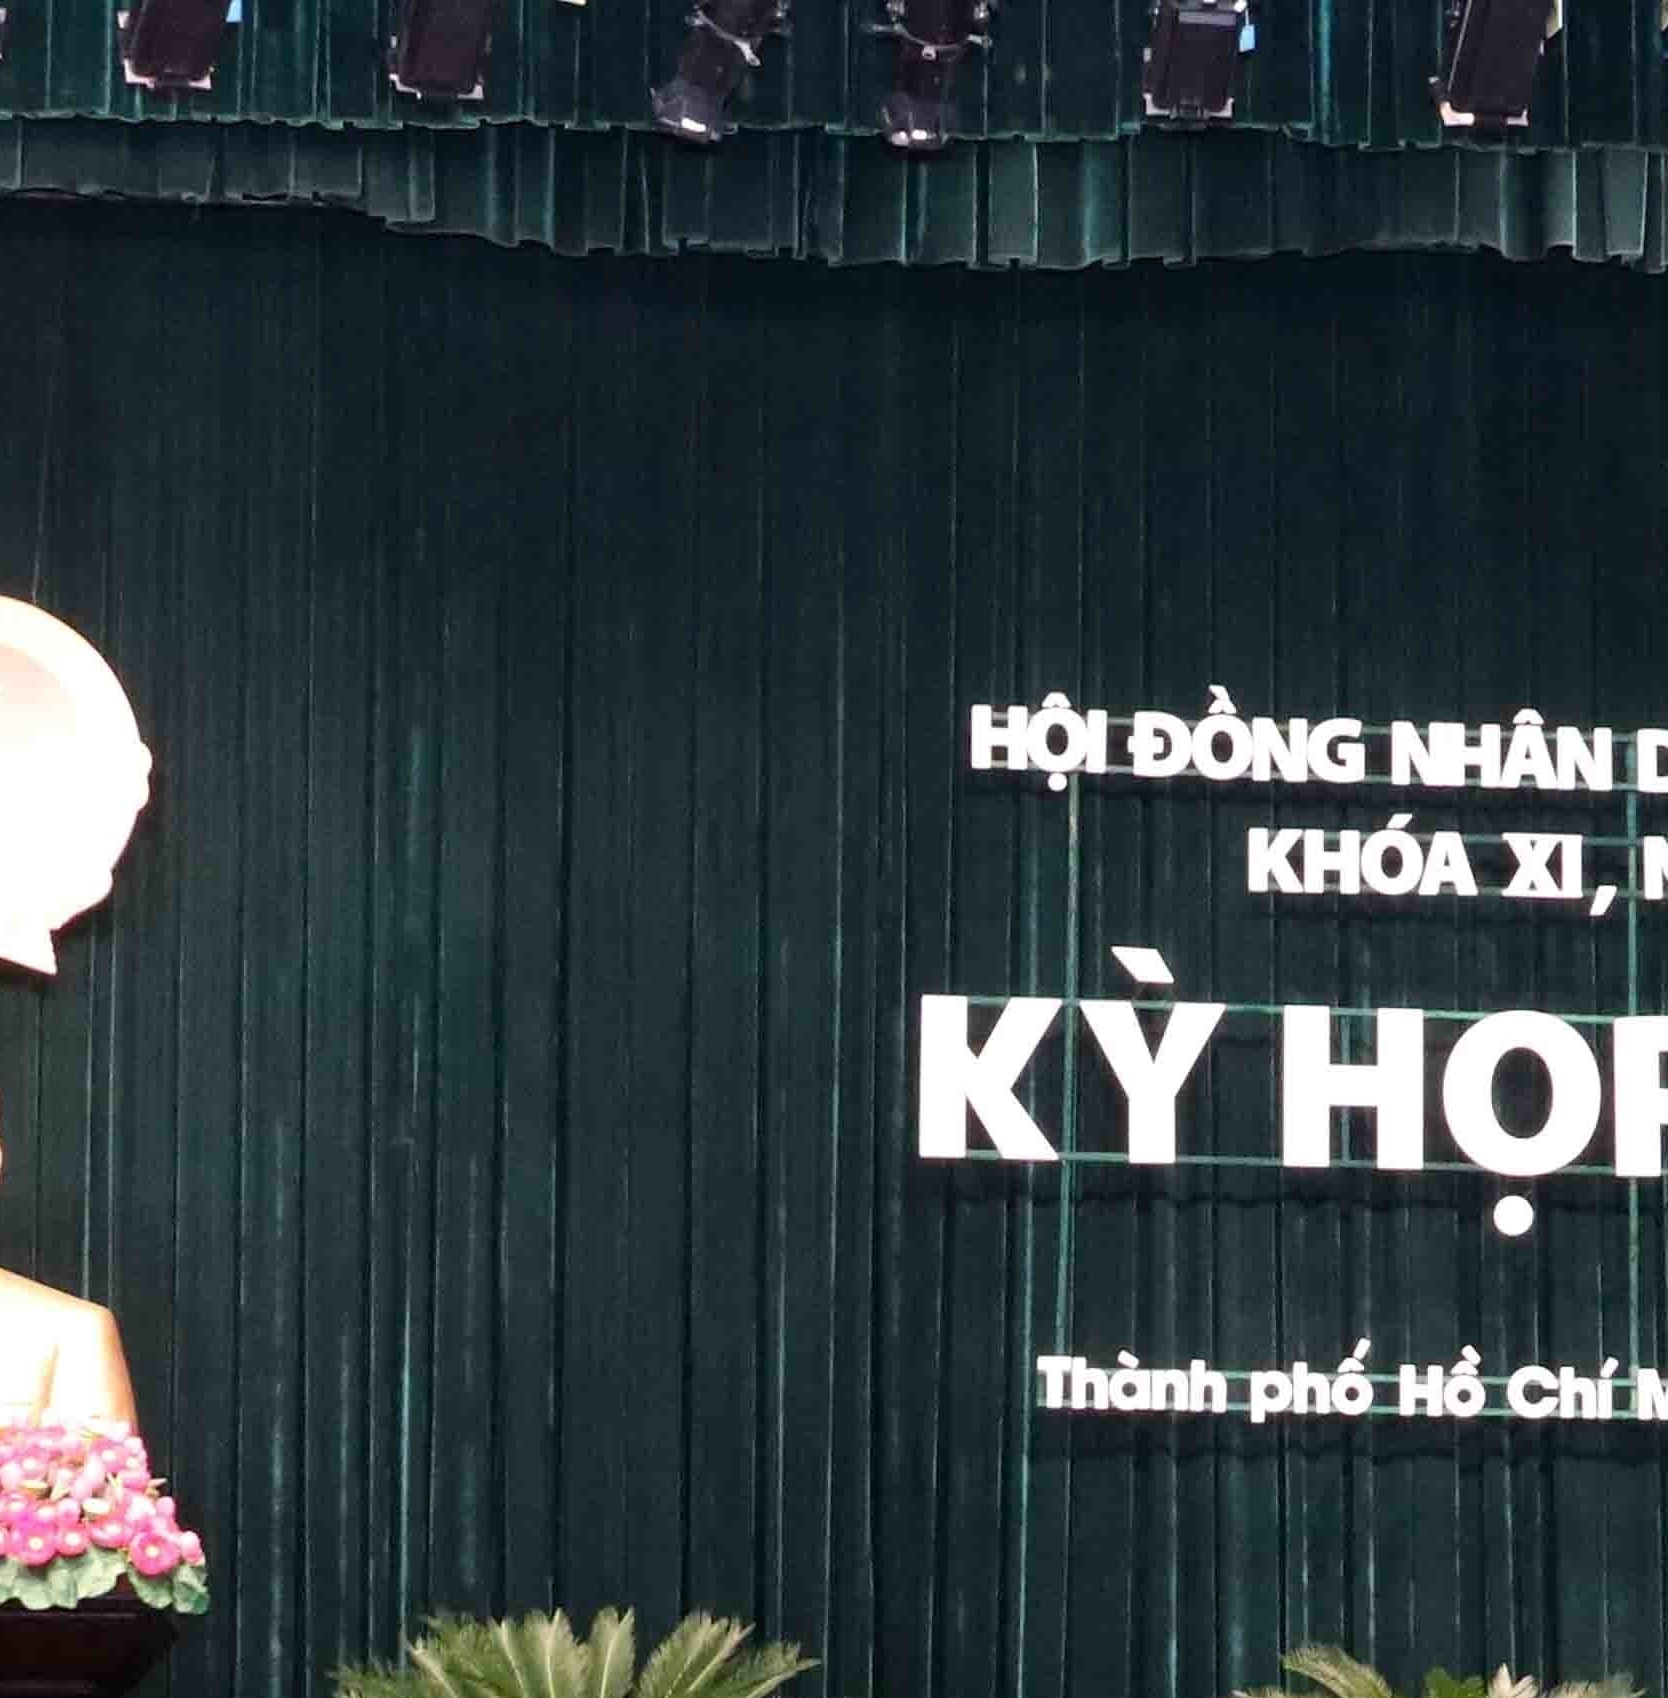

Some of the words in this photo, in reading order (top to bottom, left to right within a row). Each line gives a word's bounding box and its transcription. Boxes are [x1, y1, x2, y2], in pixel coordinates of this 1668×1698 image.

[971, 691, 1106, 791] HỘI
[1128, 685, 1365, 783] ĐỒNG
[1390, 709, 1612, 791] NHÂN
[1248, 814, 1478, 896] KHÓA
[1500, 833, 1617, 915] XI,
[919, 947, 1231, 1164] KỲ
[1037, 1350, 1227, 1413] Thành
[1251, 1338, 1374, 1423] phố
[1399, 1345, 1486, 1417] Hồ
[1507, 1357, 1619, 1420] Chí
